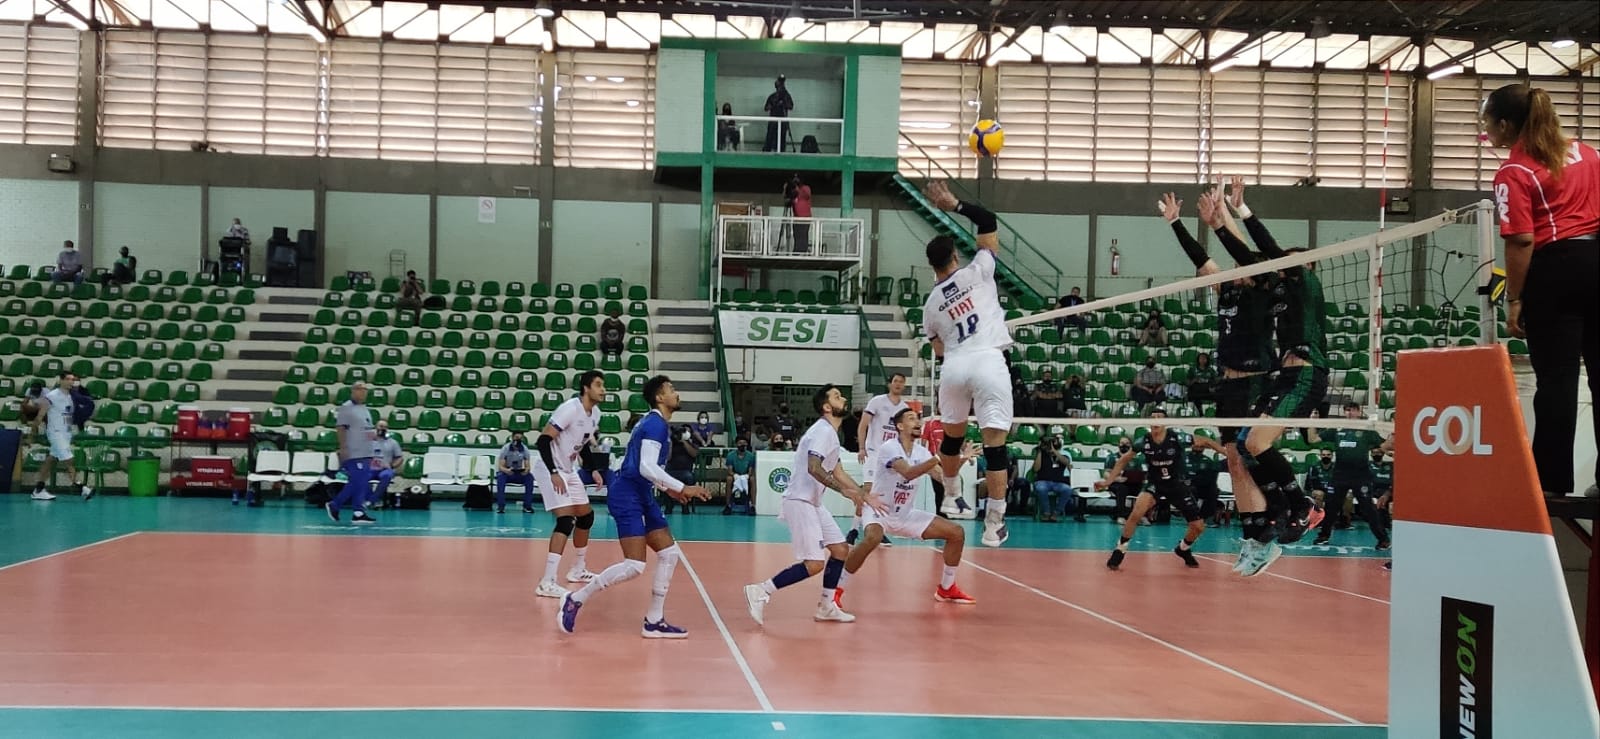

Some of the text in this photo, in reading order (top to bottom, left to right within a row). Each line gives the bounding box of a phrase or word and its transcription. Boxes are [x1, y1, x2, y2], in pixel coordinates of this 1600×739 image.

[948, 297, 975, 320] FIAT
[747, 316, 828, 343] SESI
[1413, 405, 1493, 455] GOL
